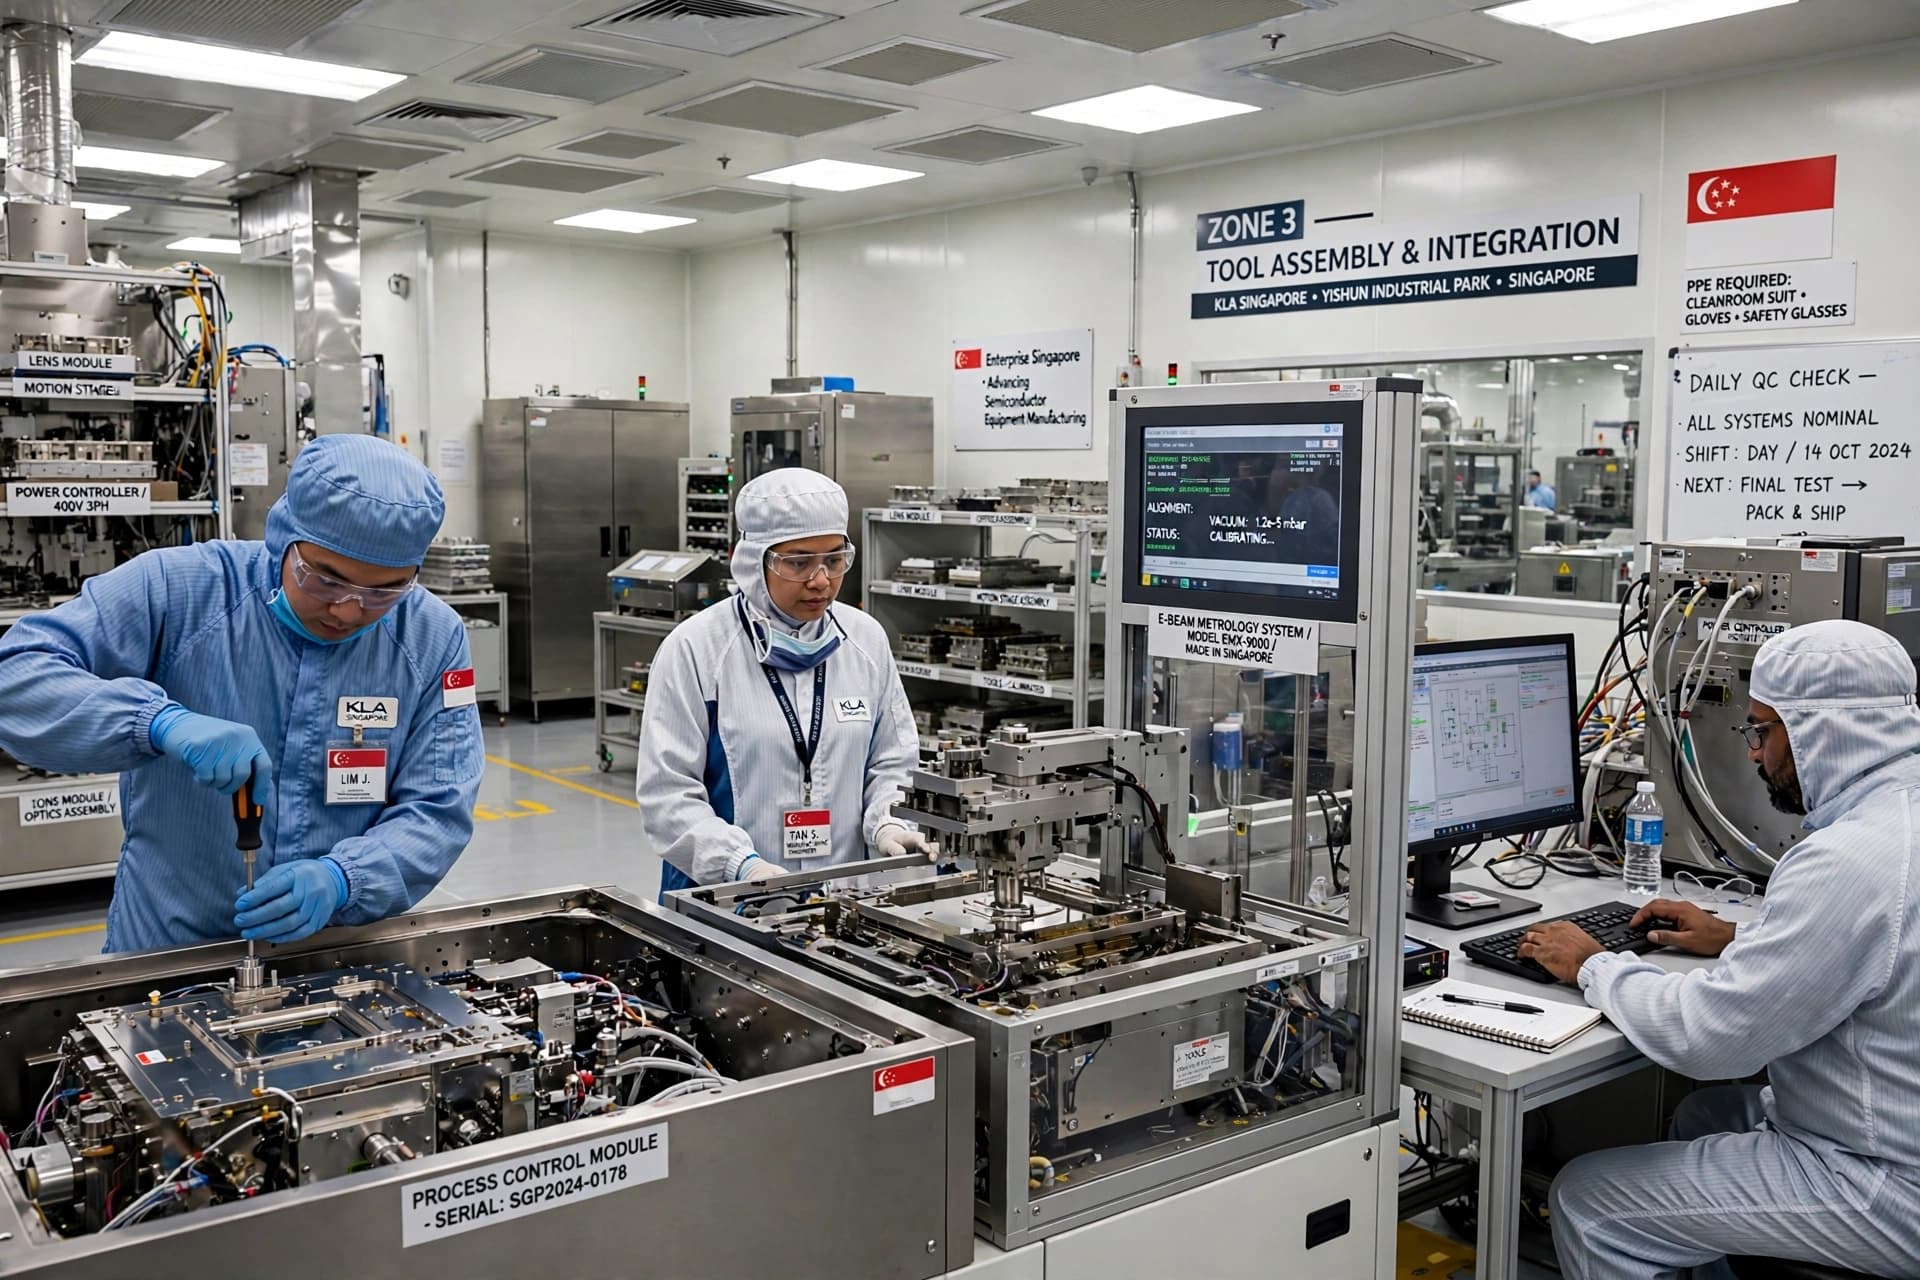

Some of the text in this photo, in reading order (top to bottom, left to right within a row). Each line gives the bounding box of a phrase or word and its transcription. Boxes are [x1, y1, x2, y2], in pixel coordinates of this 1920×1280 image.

[1207, 207, 1297, 244] ZONE 3
[1206, 217, 1620, 283] TOOL ASSEMBLY & INTEGRATION
[1214, 266, 1596, 312] KLA SINGAPORE YISHUN INDUSTRIAL PARK SINGAPORE
[1687, 272, 1792, 293] PPE REQUIRED:
[1686, 289, 1797, 309] CLEANROOM SUIT
[1685, 304, 1847, 326] GLOVES SAFETY GLASSES
[29, 355, 112, 368] LENS MODULE
[986, 349, 1080, 369] Enterprise Singapore
[25, 383, 72, 395] MOTION
[987, 375, 1030, 391] Advancing
[1690, 372, 1742, 393] DAILY
[1752, 371, 1779, 390] QC
[1790, 368, 1851, 387] CHECK
[985, 392, 1047, 408] Semiconductor
[985, 409, 1086, 429] Equipment Manufacturing
[1687, 409, 1879, 432] ALL SYSTEMS NOMINAL
[1748, 444, 1779, 461] DAY
[1786, 441, 1797, 464] /
[1805, 443, 1822, 460] 14
[1830, 443, 1861, 460] OCT
[1868, 442, 1912, 459] 2024
[15, 487, 60, 498] POWER
[63, 487, 138, 498] CONTROLLER
[1741, 476, 1786, 493] FINAL
[1794, 476, 1834, 492] TEST
[54, 501, 109, 512] 400V 3PH
[1746, 504, 1847, 521] PACK & SHIP
[1146, 528, 1181, 540] STATUS:
[1158, 613, 1195, 628] E-BEAM
[1197, 617, 1259, 634] METROLOGY
[1262, 623, 1304, 638] SYSTEM
[1187, 630, 1220, 644] MODEL
[1222, 634, 1270, 650] EMX-9000
[1186, 644, 1273, 664] MADE IN SINGAPORE
[346, 701, 387, 714] KLA
[840, 699, 865, 710] KLA
[341, 773, 370, 785] LIM J.
[62, 792, 104, 805] MODULE
[24, 803, 116, 822] OPTICS ASSEMBLY
[789, 829, 808, 840] TAN
[413, 1133, 658, 1209] PROCESS CONTROL MODULE
[435, 1199, 504, 1228] SERIAL:
[510, 1164, 628, 1209] SGP2024-0178
